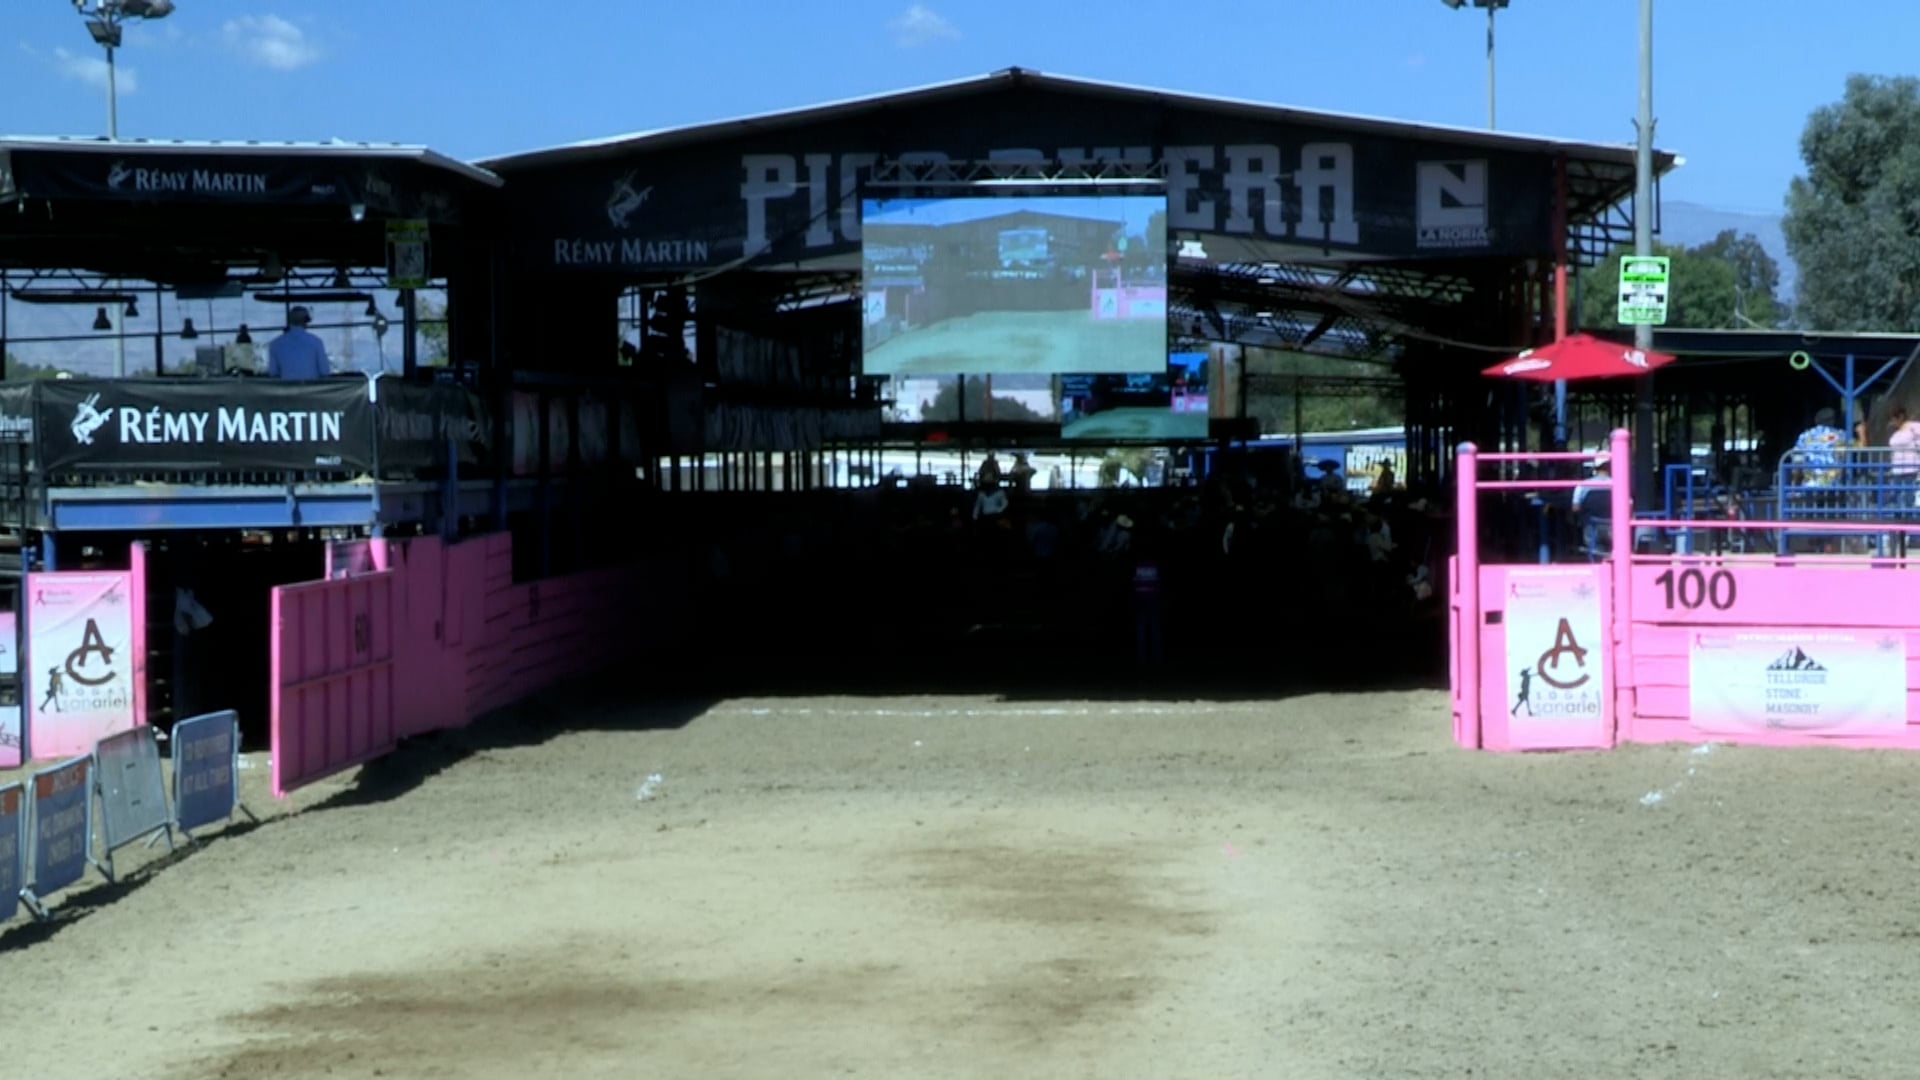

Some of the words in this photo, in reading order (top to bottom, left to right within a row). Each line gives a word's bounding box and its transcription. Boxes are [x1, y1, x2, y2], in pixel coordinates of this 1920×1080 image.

[135, 167, 187, 191] RÉMY
[192, 169, 267, 193] MARTIN
[553, 237, 617, 265] RÉMY
[620, 238, 709, 264] MARTIN
[119, 405, 209, 444] RÉMY
[217, 406, 341, 443] MARTIN
[1655, 568, 1737, 610] 100
